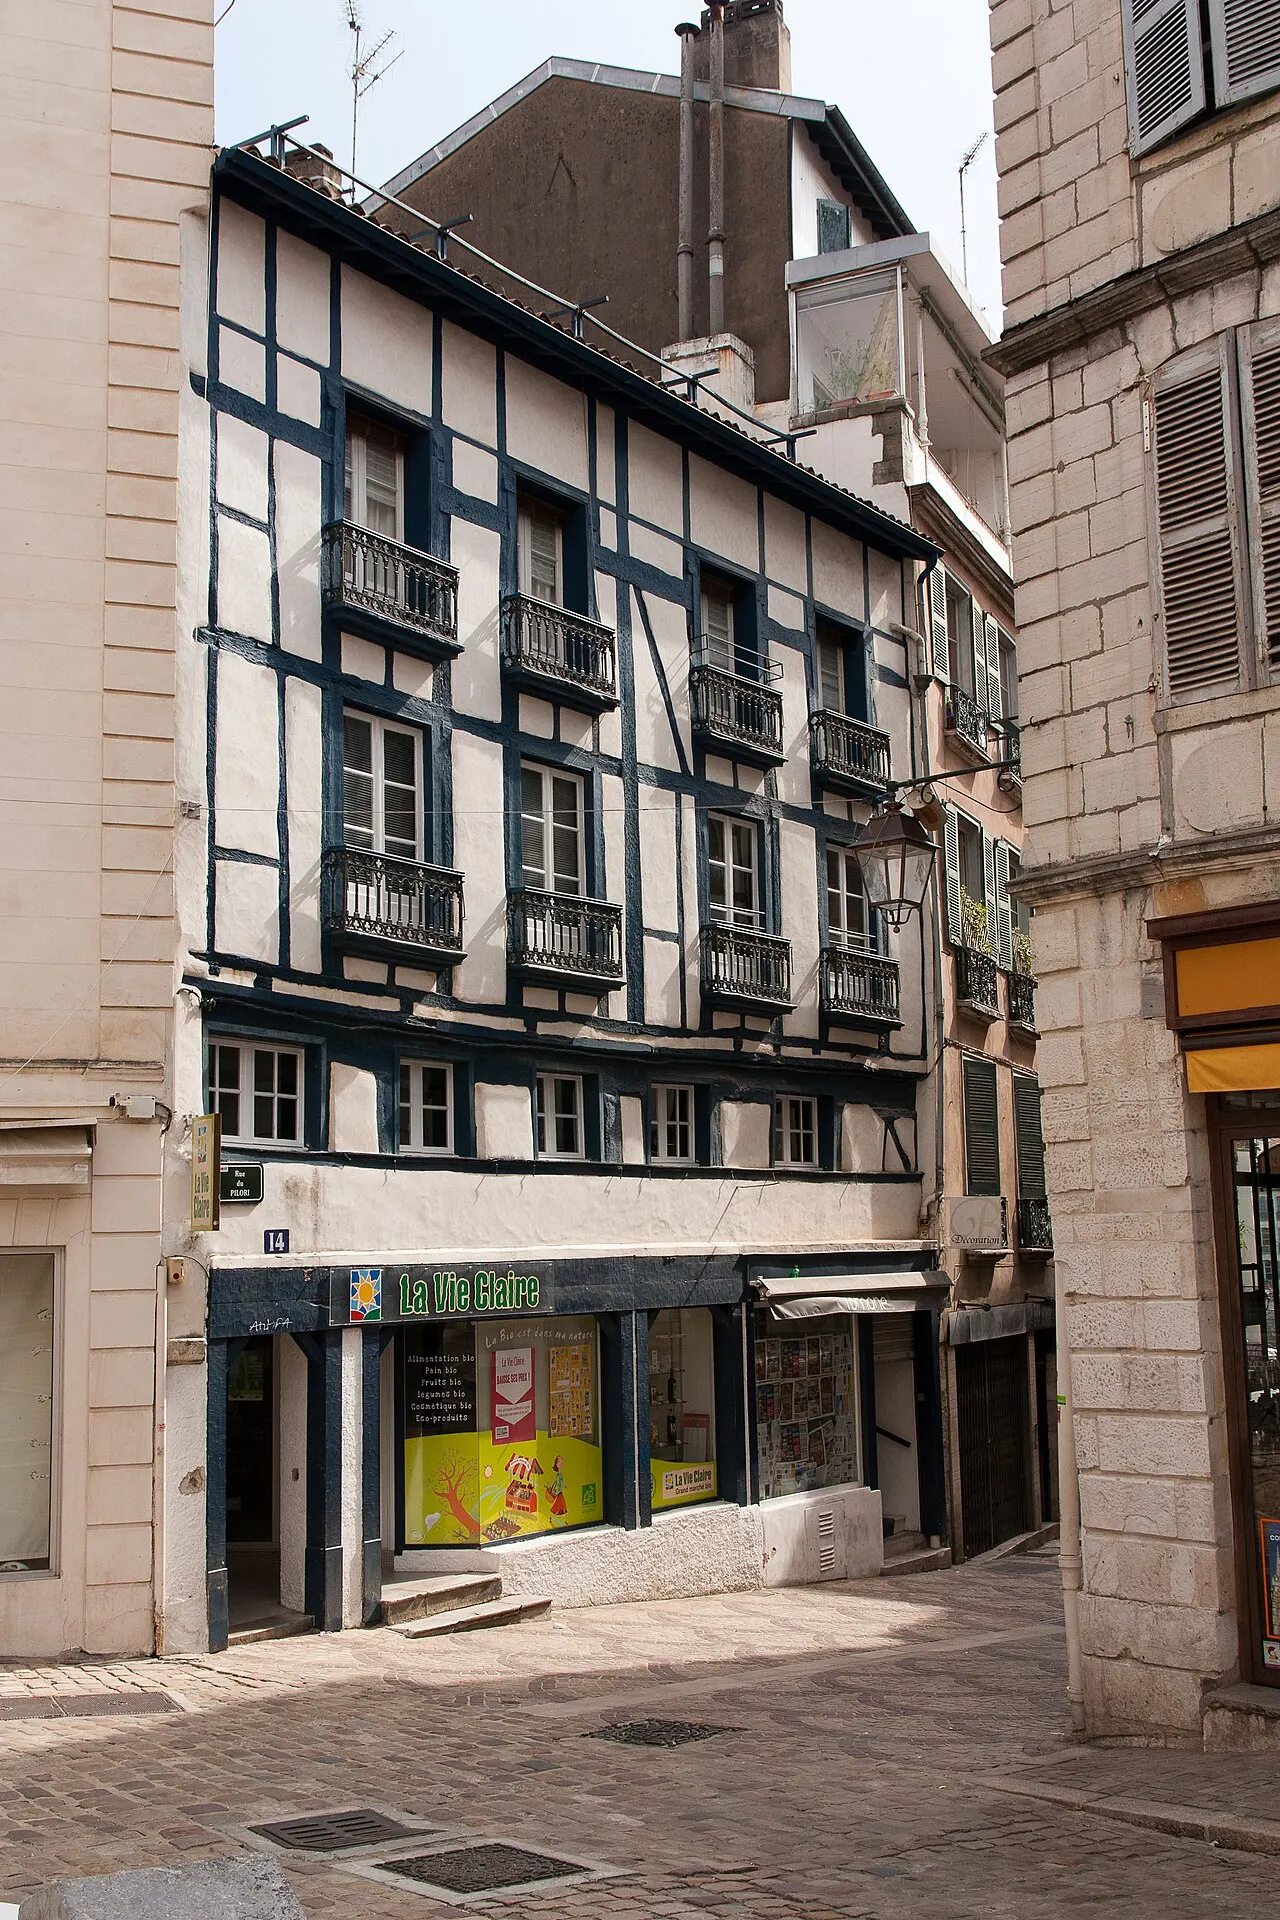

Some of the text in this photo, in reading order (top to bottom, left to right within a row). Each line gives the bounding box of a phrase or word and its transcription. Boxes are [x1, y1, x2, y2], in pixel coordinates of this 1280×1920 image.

[194, 1172, 209, 1193] La Vie
[230, 1189, 250, 1197] PILORI
[194, 1195, 209, 1218] Claire
[268, 1232, 285, 1251] 14
[400, 1270, 539, 1315] La Vie Claire
[485, 1336, 497, 1348] La
[517, 1327, 531, 1338] est
[407, 1354, 475, 1363] Alimentation bio
[425, 1366, 458, 1374] Pain bio
[421, 1378, 462, 1386] Fruits bio
[454, 1390, 466, 1398] bio
[460, 1401, 473, 1410] bio
[416, 1413, 468, 1424] Eco-produits
[675, 1469, 712, 1487] La Vie Claire
